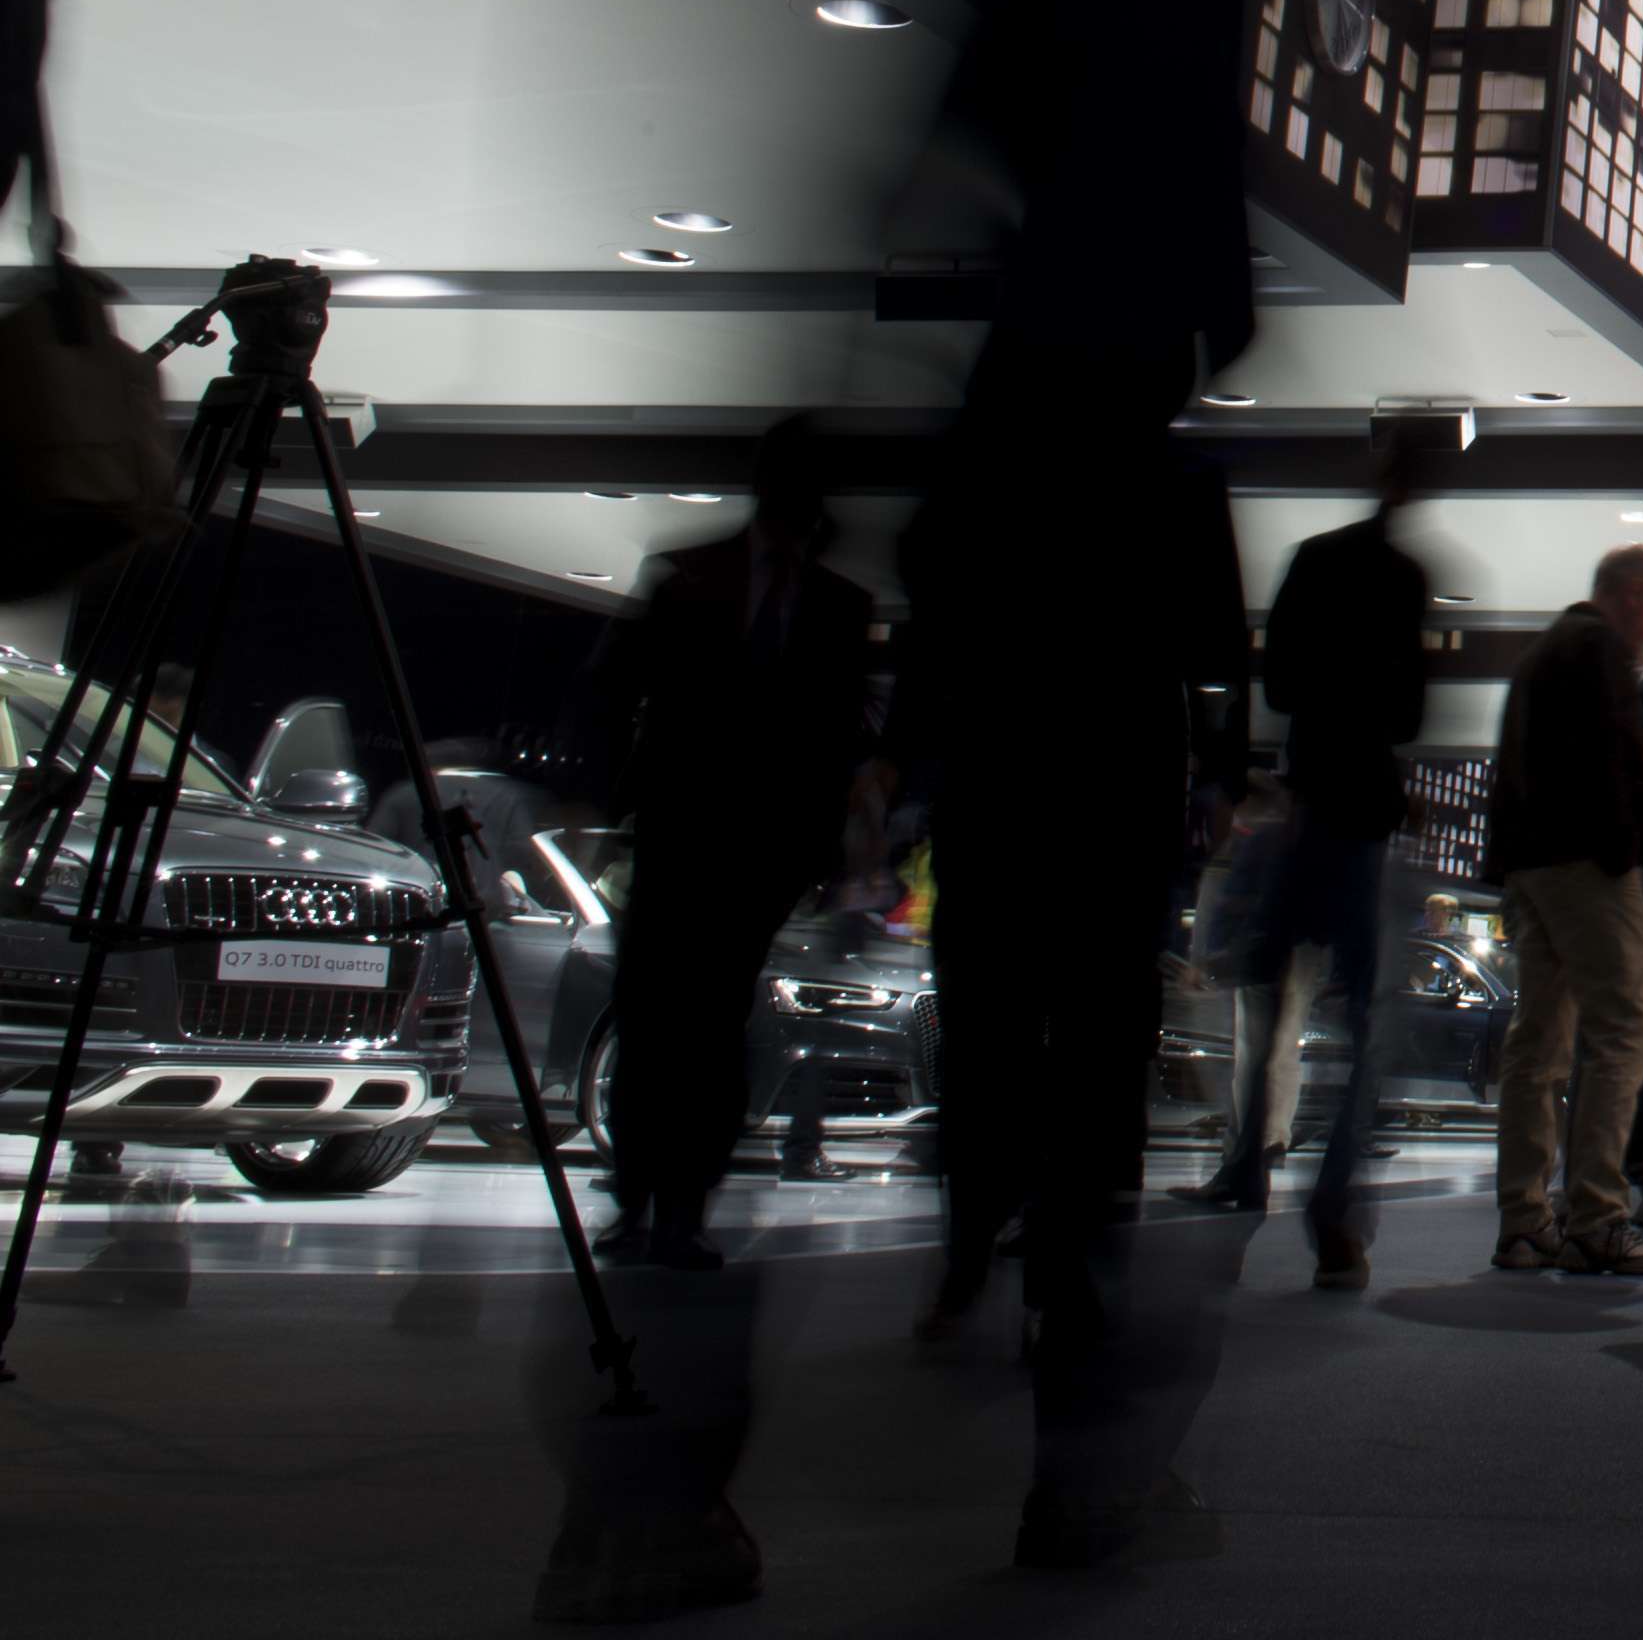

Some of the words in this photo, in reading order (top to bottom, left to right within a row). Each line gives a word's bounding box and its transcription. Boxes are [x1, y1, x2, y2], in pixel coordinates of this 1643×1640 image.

[225, 951, 252, 968] Q7
[257, 952, 287, 968] 3.0
[291, 953, 321, 969] TDI
[324, 957, 385, 973] quattro
